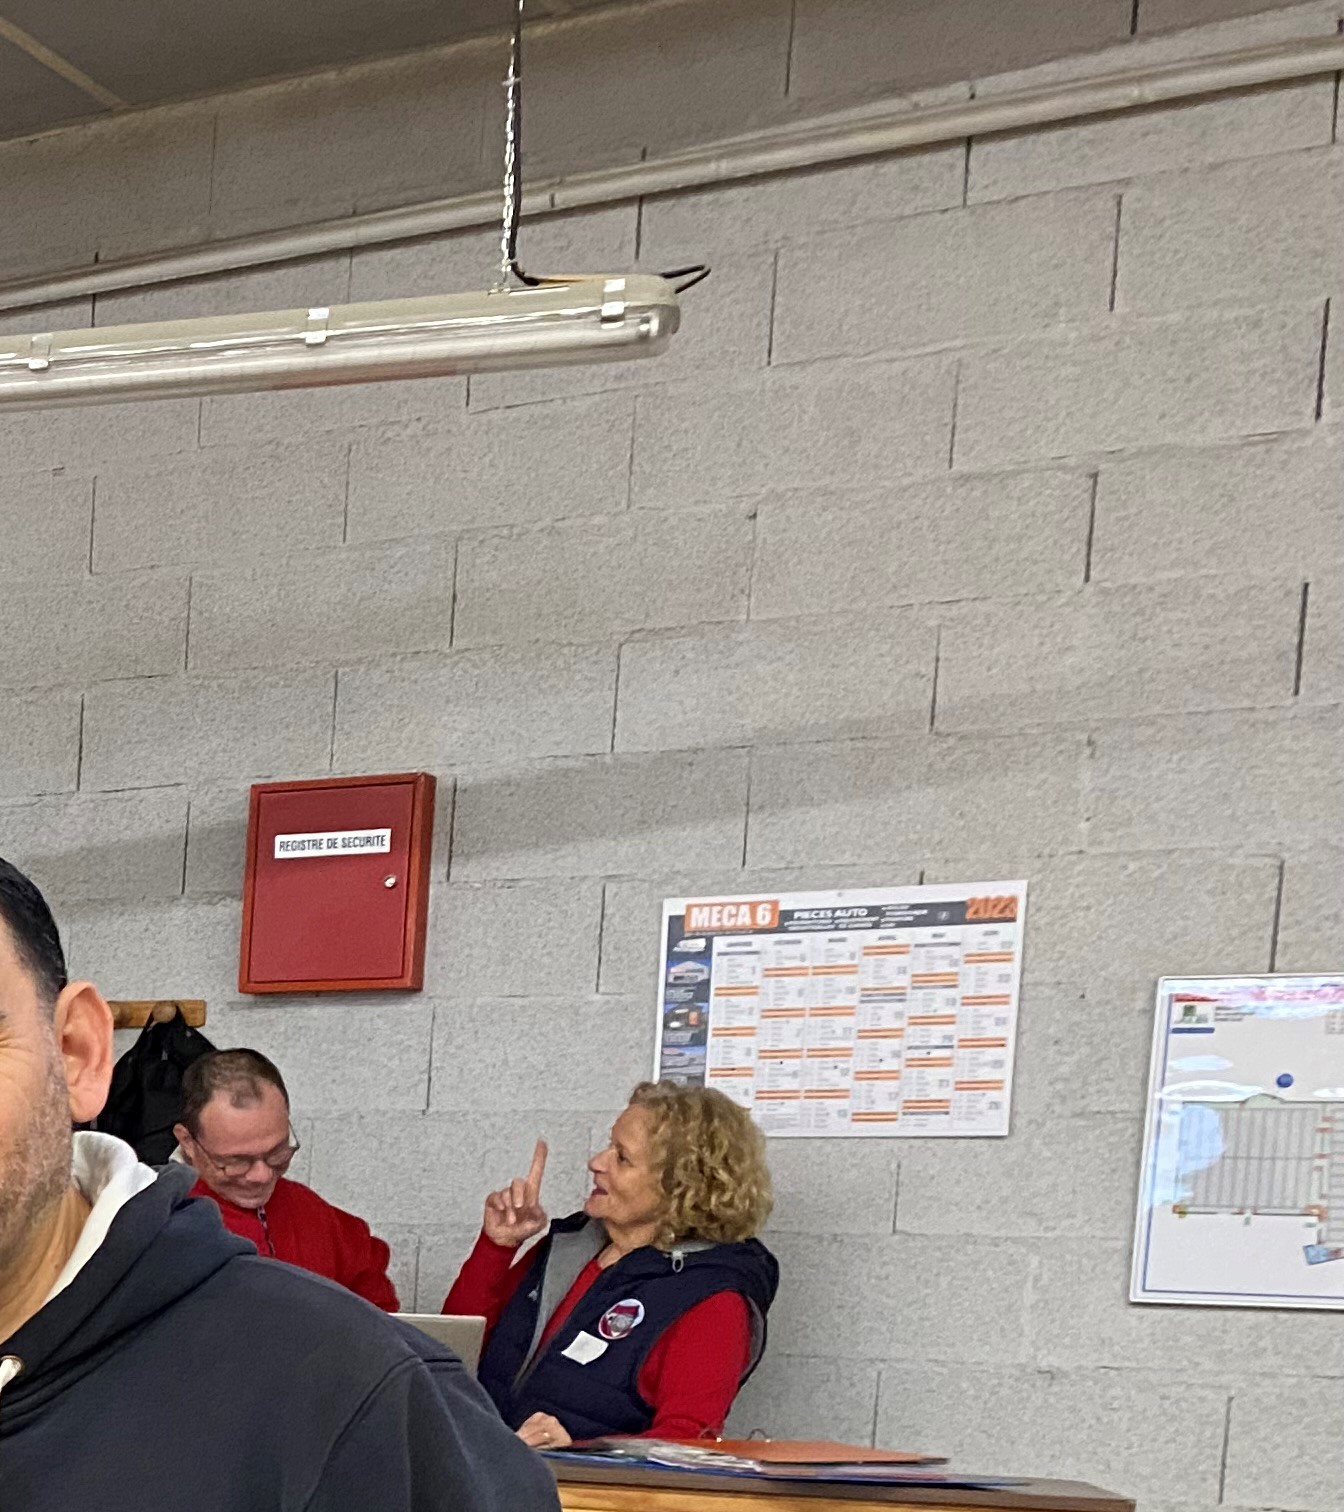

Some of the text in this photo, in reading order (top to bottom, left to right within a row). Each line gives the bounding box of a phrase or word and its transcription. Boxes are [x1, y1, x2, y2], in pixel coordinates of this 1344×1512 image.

[279, 834, 387, 852] REGISTRE DE SECURITE
[690, 903, 753, 929] MECA
[756, 902, 773, 926] 6
[793, 909, 833, 920] PIECES
[834, 907, 869, 918] AUTO
